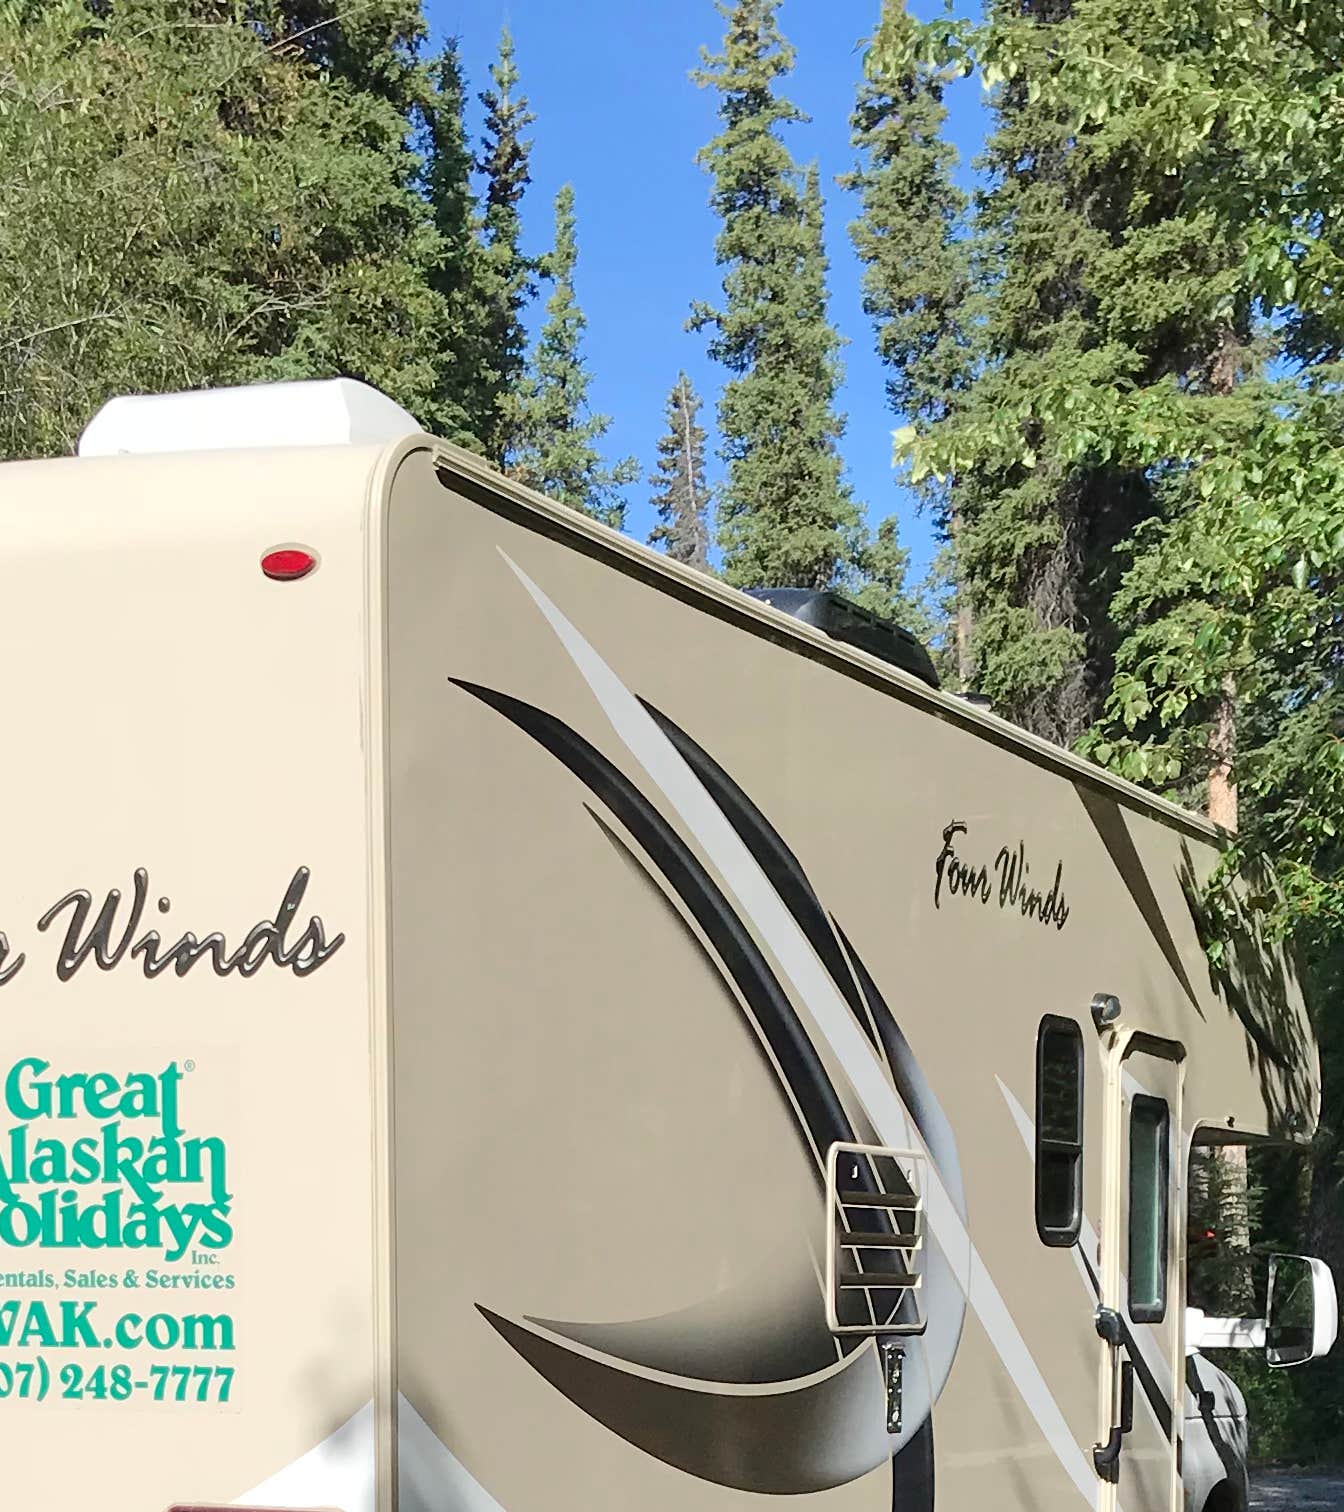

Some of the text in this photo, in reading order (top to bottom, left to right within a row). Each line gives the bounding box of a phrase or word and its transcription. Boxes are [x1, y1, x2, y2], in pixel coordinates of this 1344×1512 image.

[935, 819, 1070, 930] Four Winds
[37, 865, 346, 982] Winds
[5, 1057, 184, 1138] Great
[64, 1269, 118, 1289] Sales
[122, 1269, 140, 1288] &
[145, 1269, 235, 1289] Services
[191, 1250, 220, 1265] Inc.
[60, 1363, 235, 1402] 248-7777
